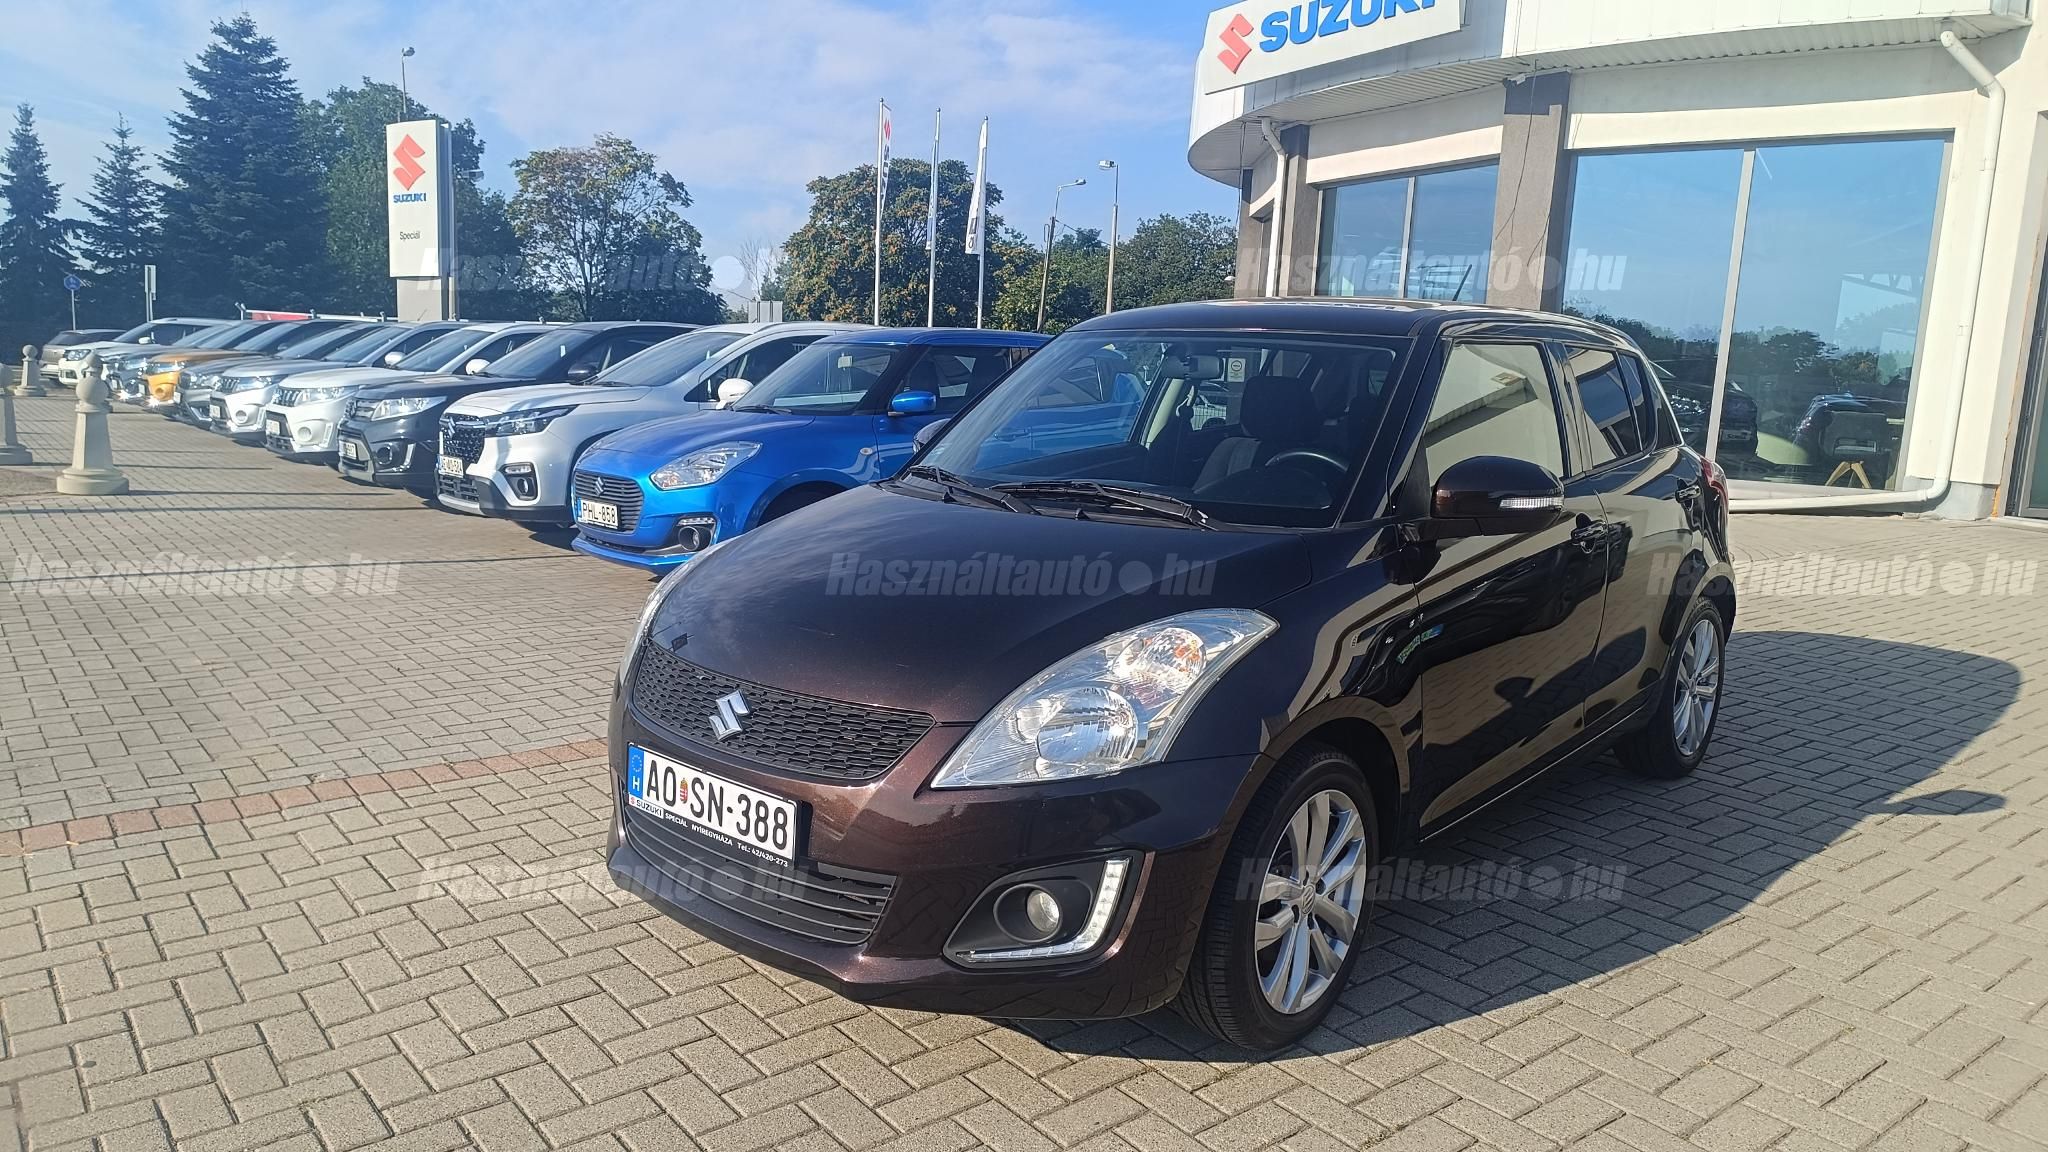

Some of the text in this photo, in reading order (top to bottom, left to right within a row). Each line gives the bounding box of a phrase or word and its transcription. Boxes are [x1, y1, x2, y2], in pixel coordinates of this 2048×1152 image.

[1259, 0, 1436, 52] SUZU
[393, 192, 427, 203] SUZUKI
[582, 502, 616, 524] PHL-858
[636, 799, 662, 817] SUZUKI
[646, 759, 788, 851] AO SN-388
